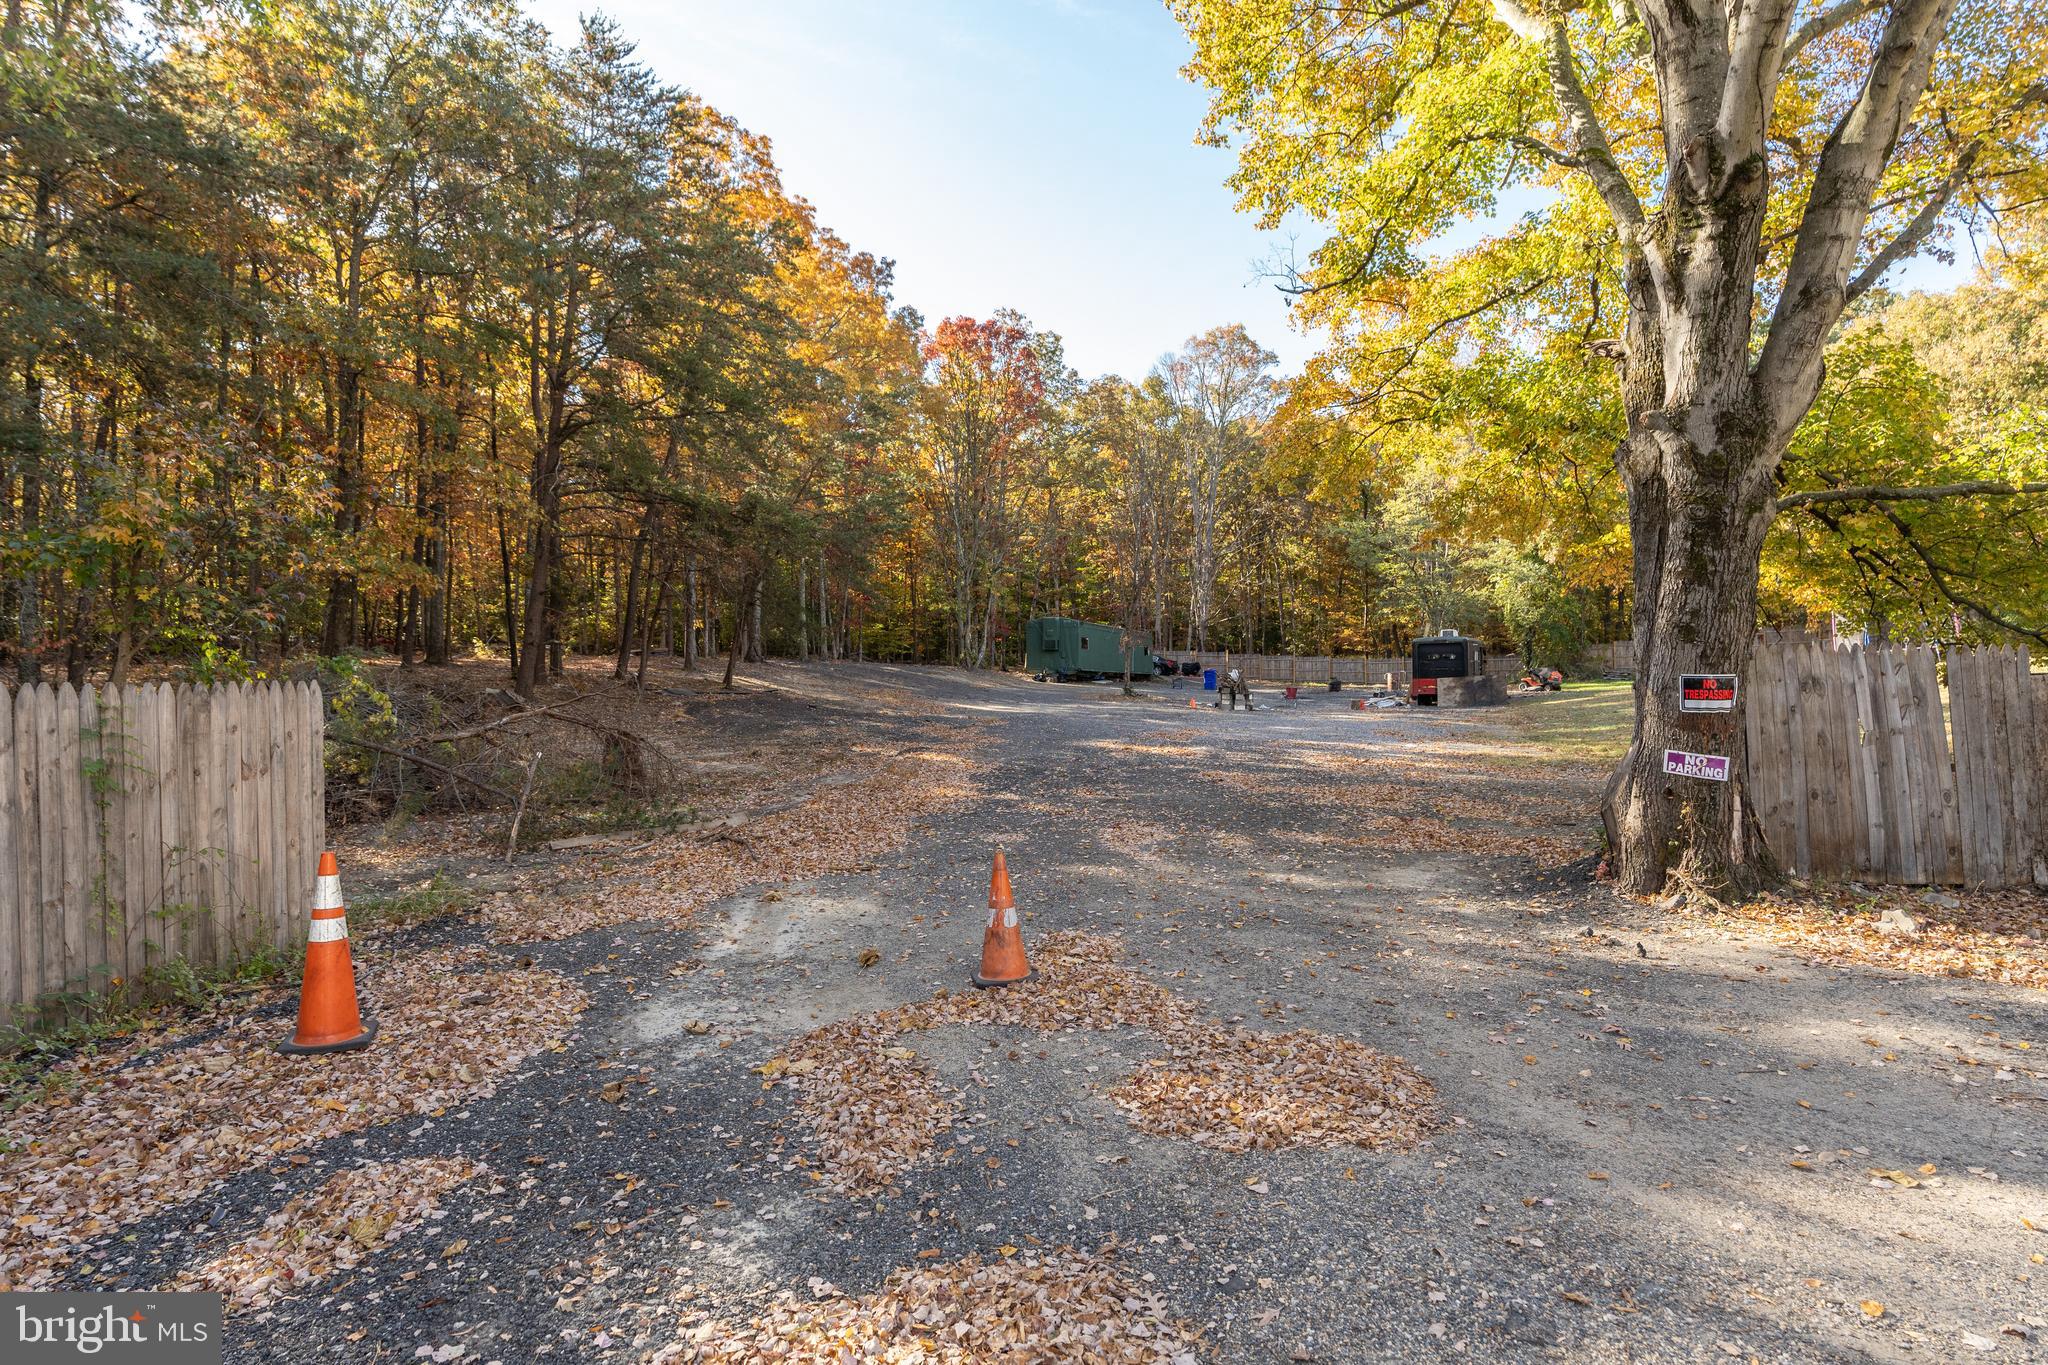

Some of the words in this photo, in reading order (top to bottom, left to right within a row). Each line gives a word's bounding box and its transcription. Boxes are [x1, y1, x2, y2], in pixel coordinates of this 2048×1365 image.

[1703, 679, 1717, 689] NO
[1685, 690, 1733, 699] TRESPASSING
[1685, 755, 1707, 766] NO
[1668, 762, 1723, 778] PARKING
